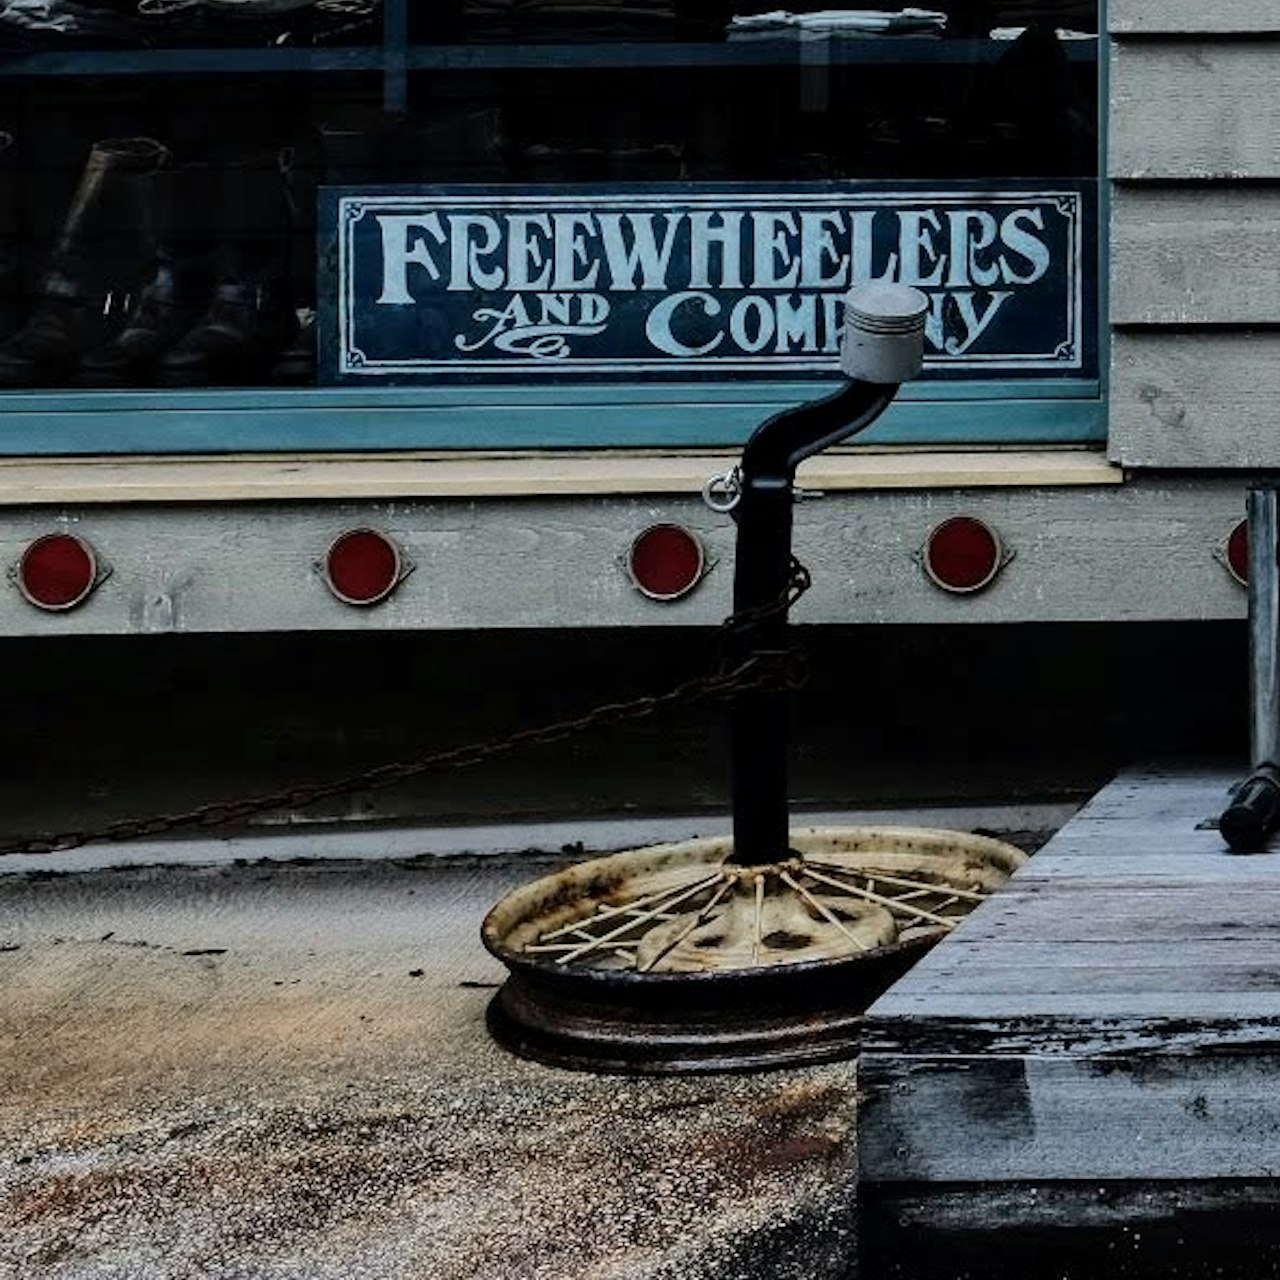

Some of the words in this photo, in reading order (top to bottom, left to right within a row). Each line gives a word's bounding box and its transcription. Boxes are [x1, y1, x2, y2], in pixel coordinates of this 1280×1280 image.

[375, 208, 1051, 304] FREEWHEELERS
[455, 293, 612, 358] AND
[645, 291, 1015, 357] COMPNY
